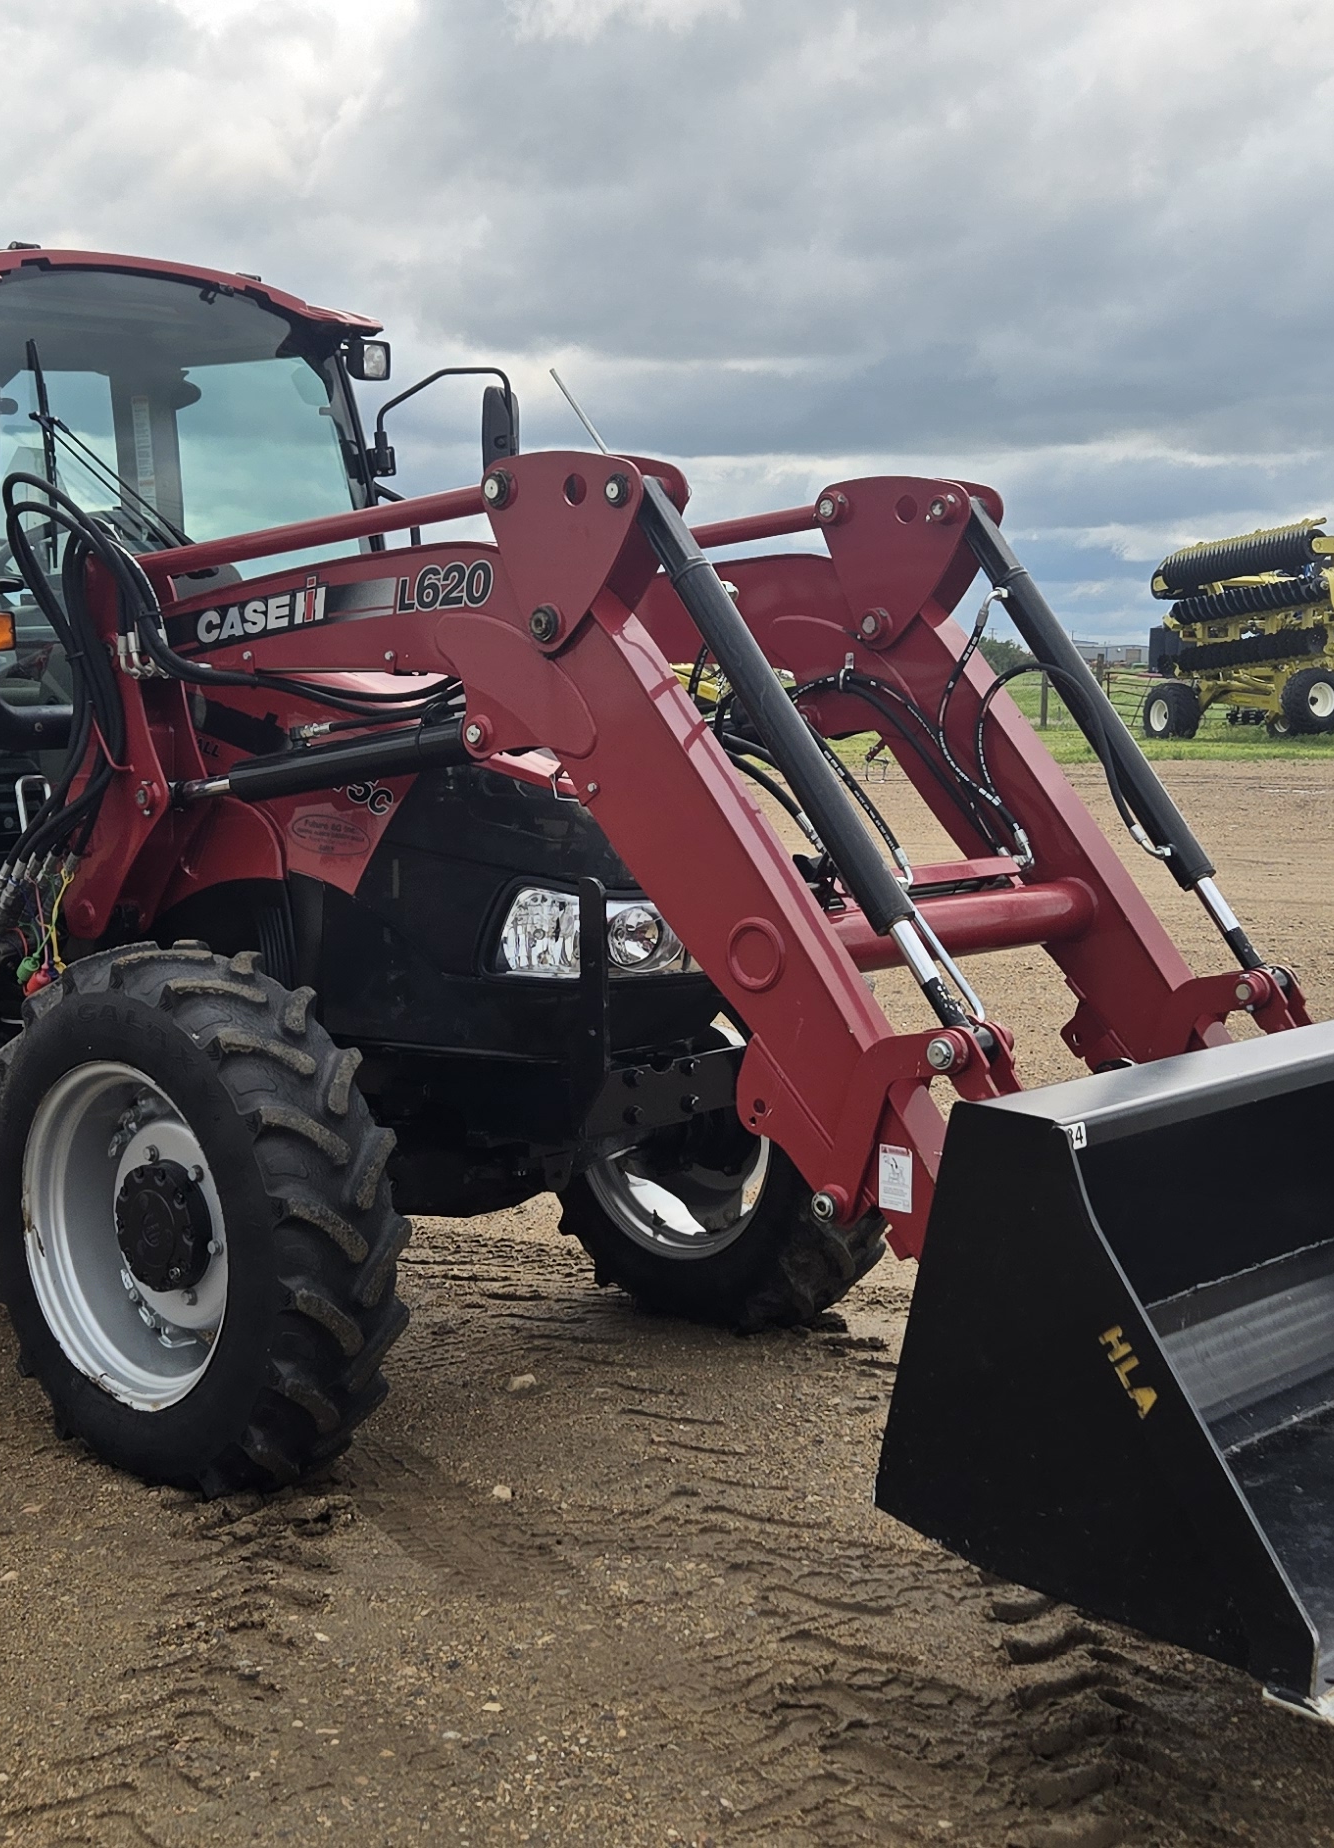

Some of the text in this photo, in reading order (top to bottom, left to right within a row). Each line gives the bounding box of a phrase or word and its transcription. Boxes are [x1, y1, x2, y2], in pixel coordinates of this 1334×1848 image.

[395, 558, 494, 615] L620
[197, 594, 290, 643] CASE
[333, 780, 394, 816] 5C
[1098, 1324, 1158, 1420] HLA
